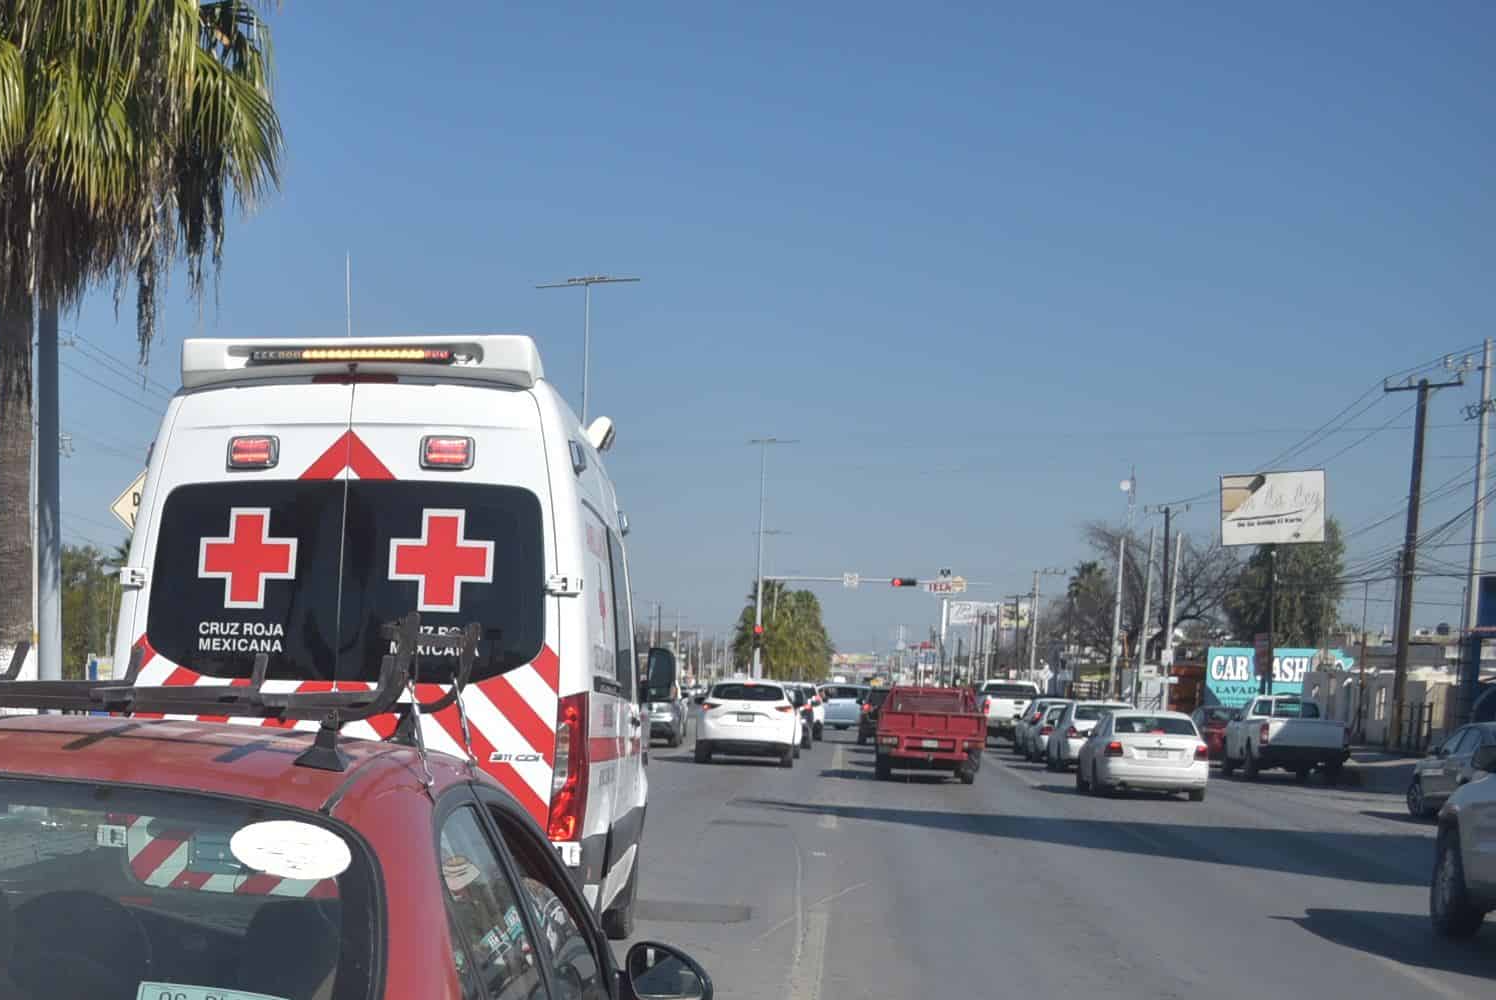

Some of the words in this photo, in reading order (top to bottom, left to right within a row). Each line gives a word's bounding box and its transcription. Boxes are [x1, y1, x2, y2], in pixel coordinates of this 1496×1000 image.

[199, 621, 239, 635] CRUZ
[243, 622, 284, 636] ROJA
[198, 638, 283, 652] MEXICANA
[1211, 656, 1249, 680] CAR
[1256, 656, 1308, 682] ASH
